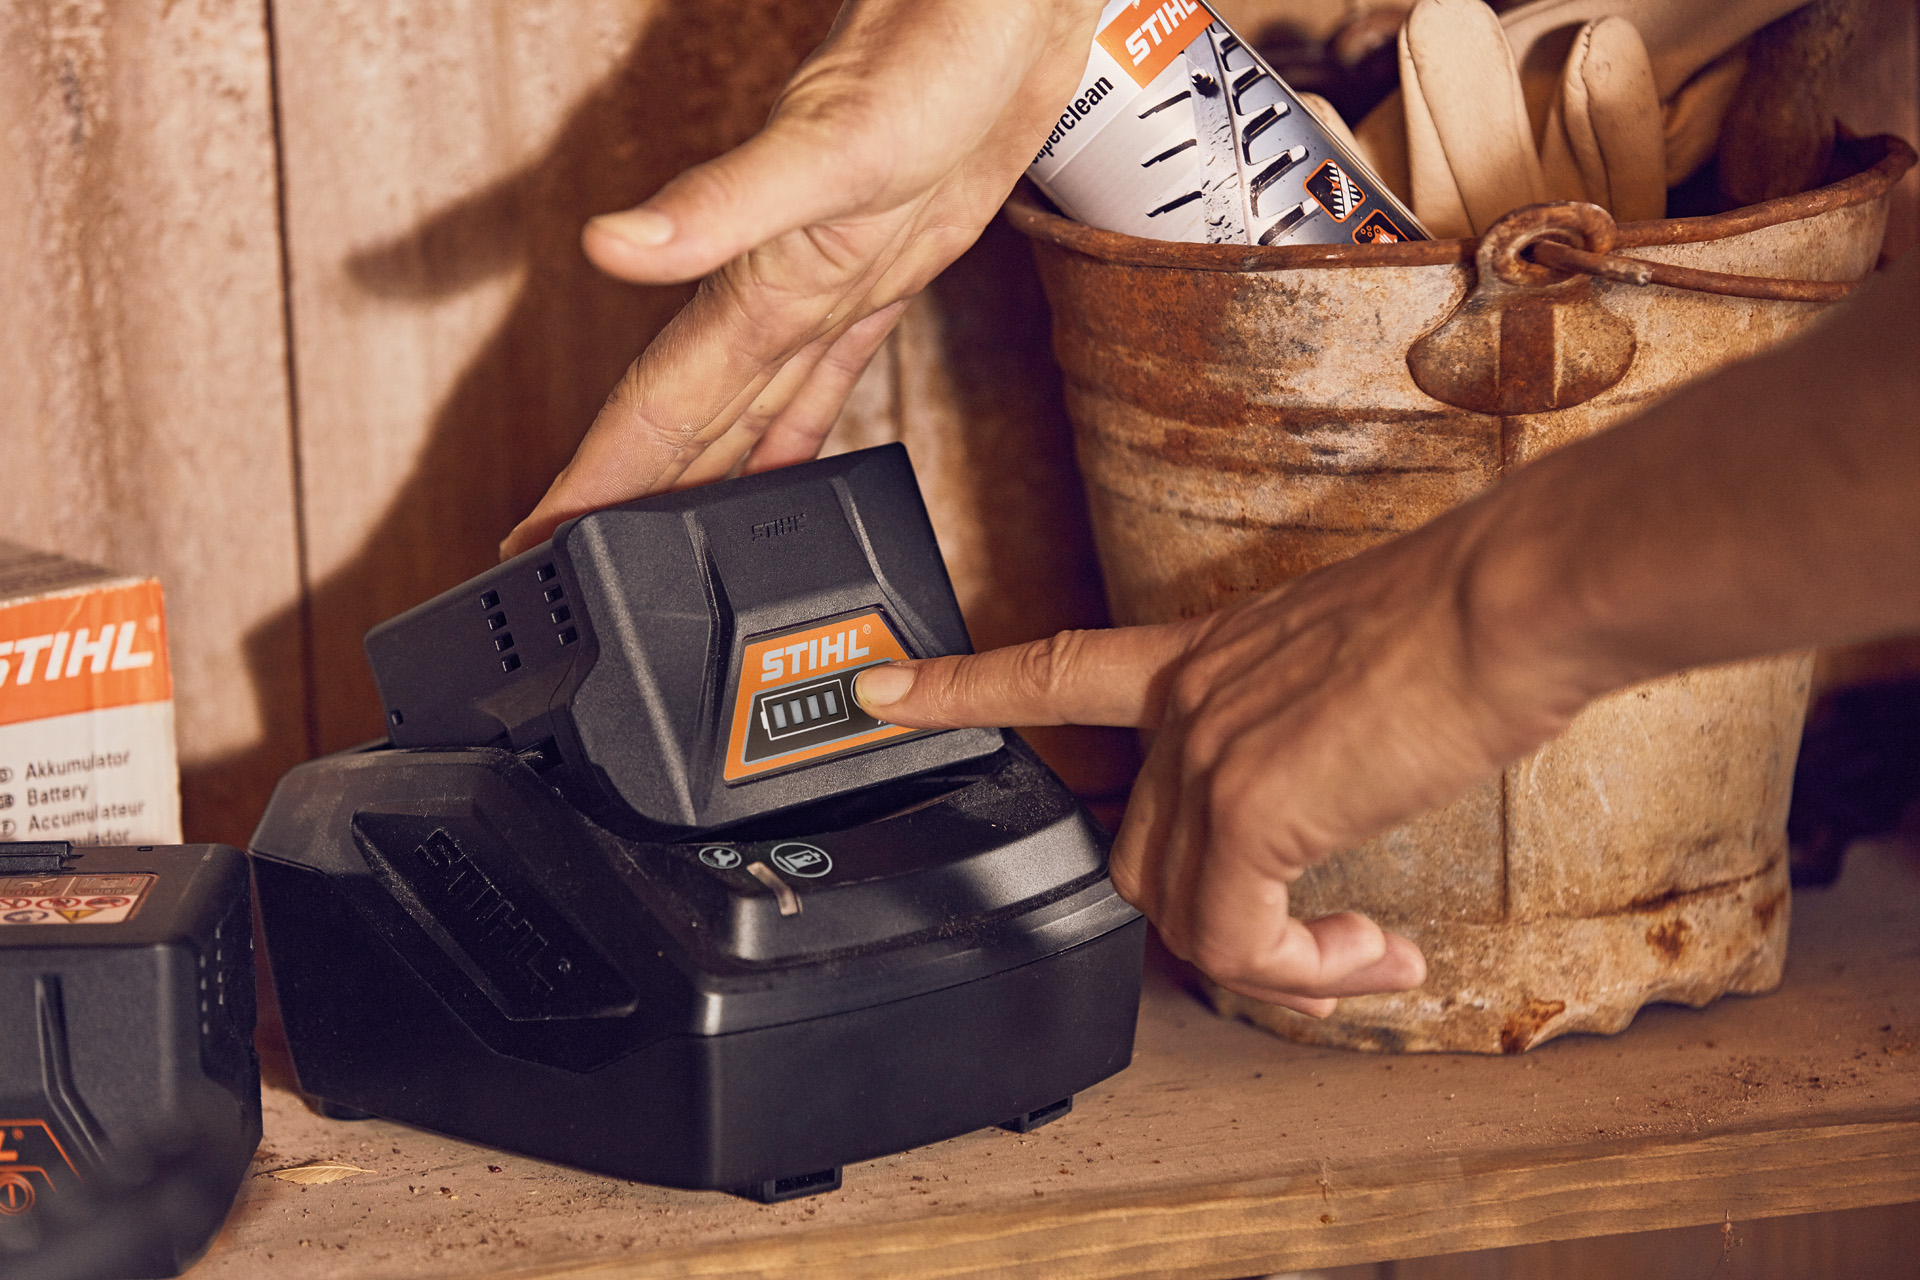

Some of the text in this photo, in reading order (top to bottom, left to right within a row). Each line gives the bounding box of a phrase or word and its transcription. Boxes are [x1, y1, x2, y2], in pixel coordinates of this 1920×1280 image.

[1125, 0, 1198, 67] STIHL
[751, 514, 802, 542] STIHL
[761, 628, 870, 683] STIHL
[25, 751, 130, 781] Akkumulator
[27, 784, 88, 807] Battery
[28, 802, 145, 834] Accumulateur
[414, 828, 555, 996] STIHL
